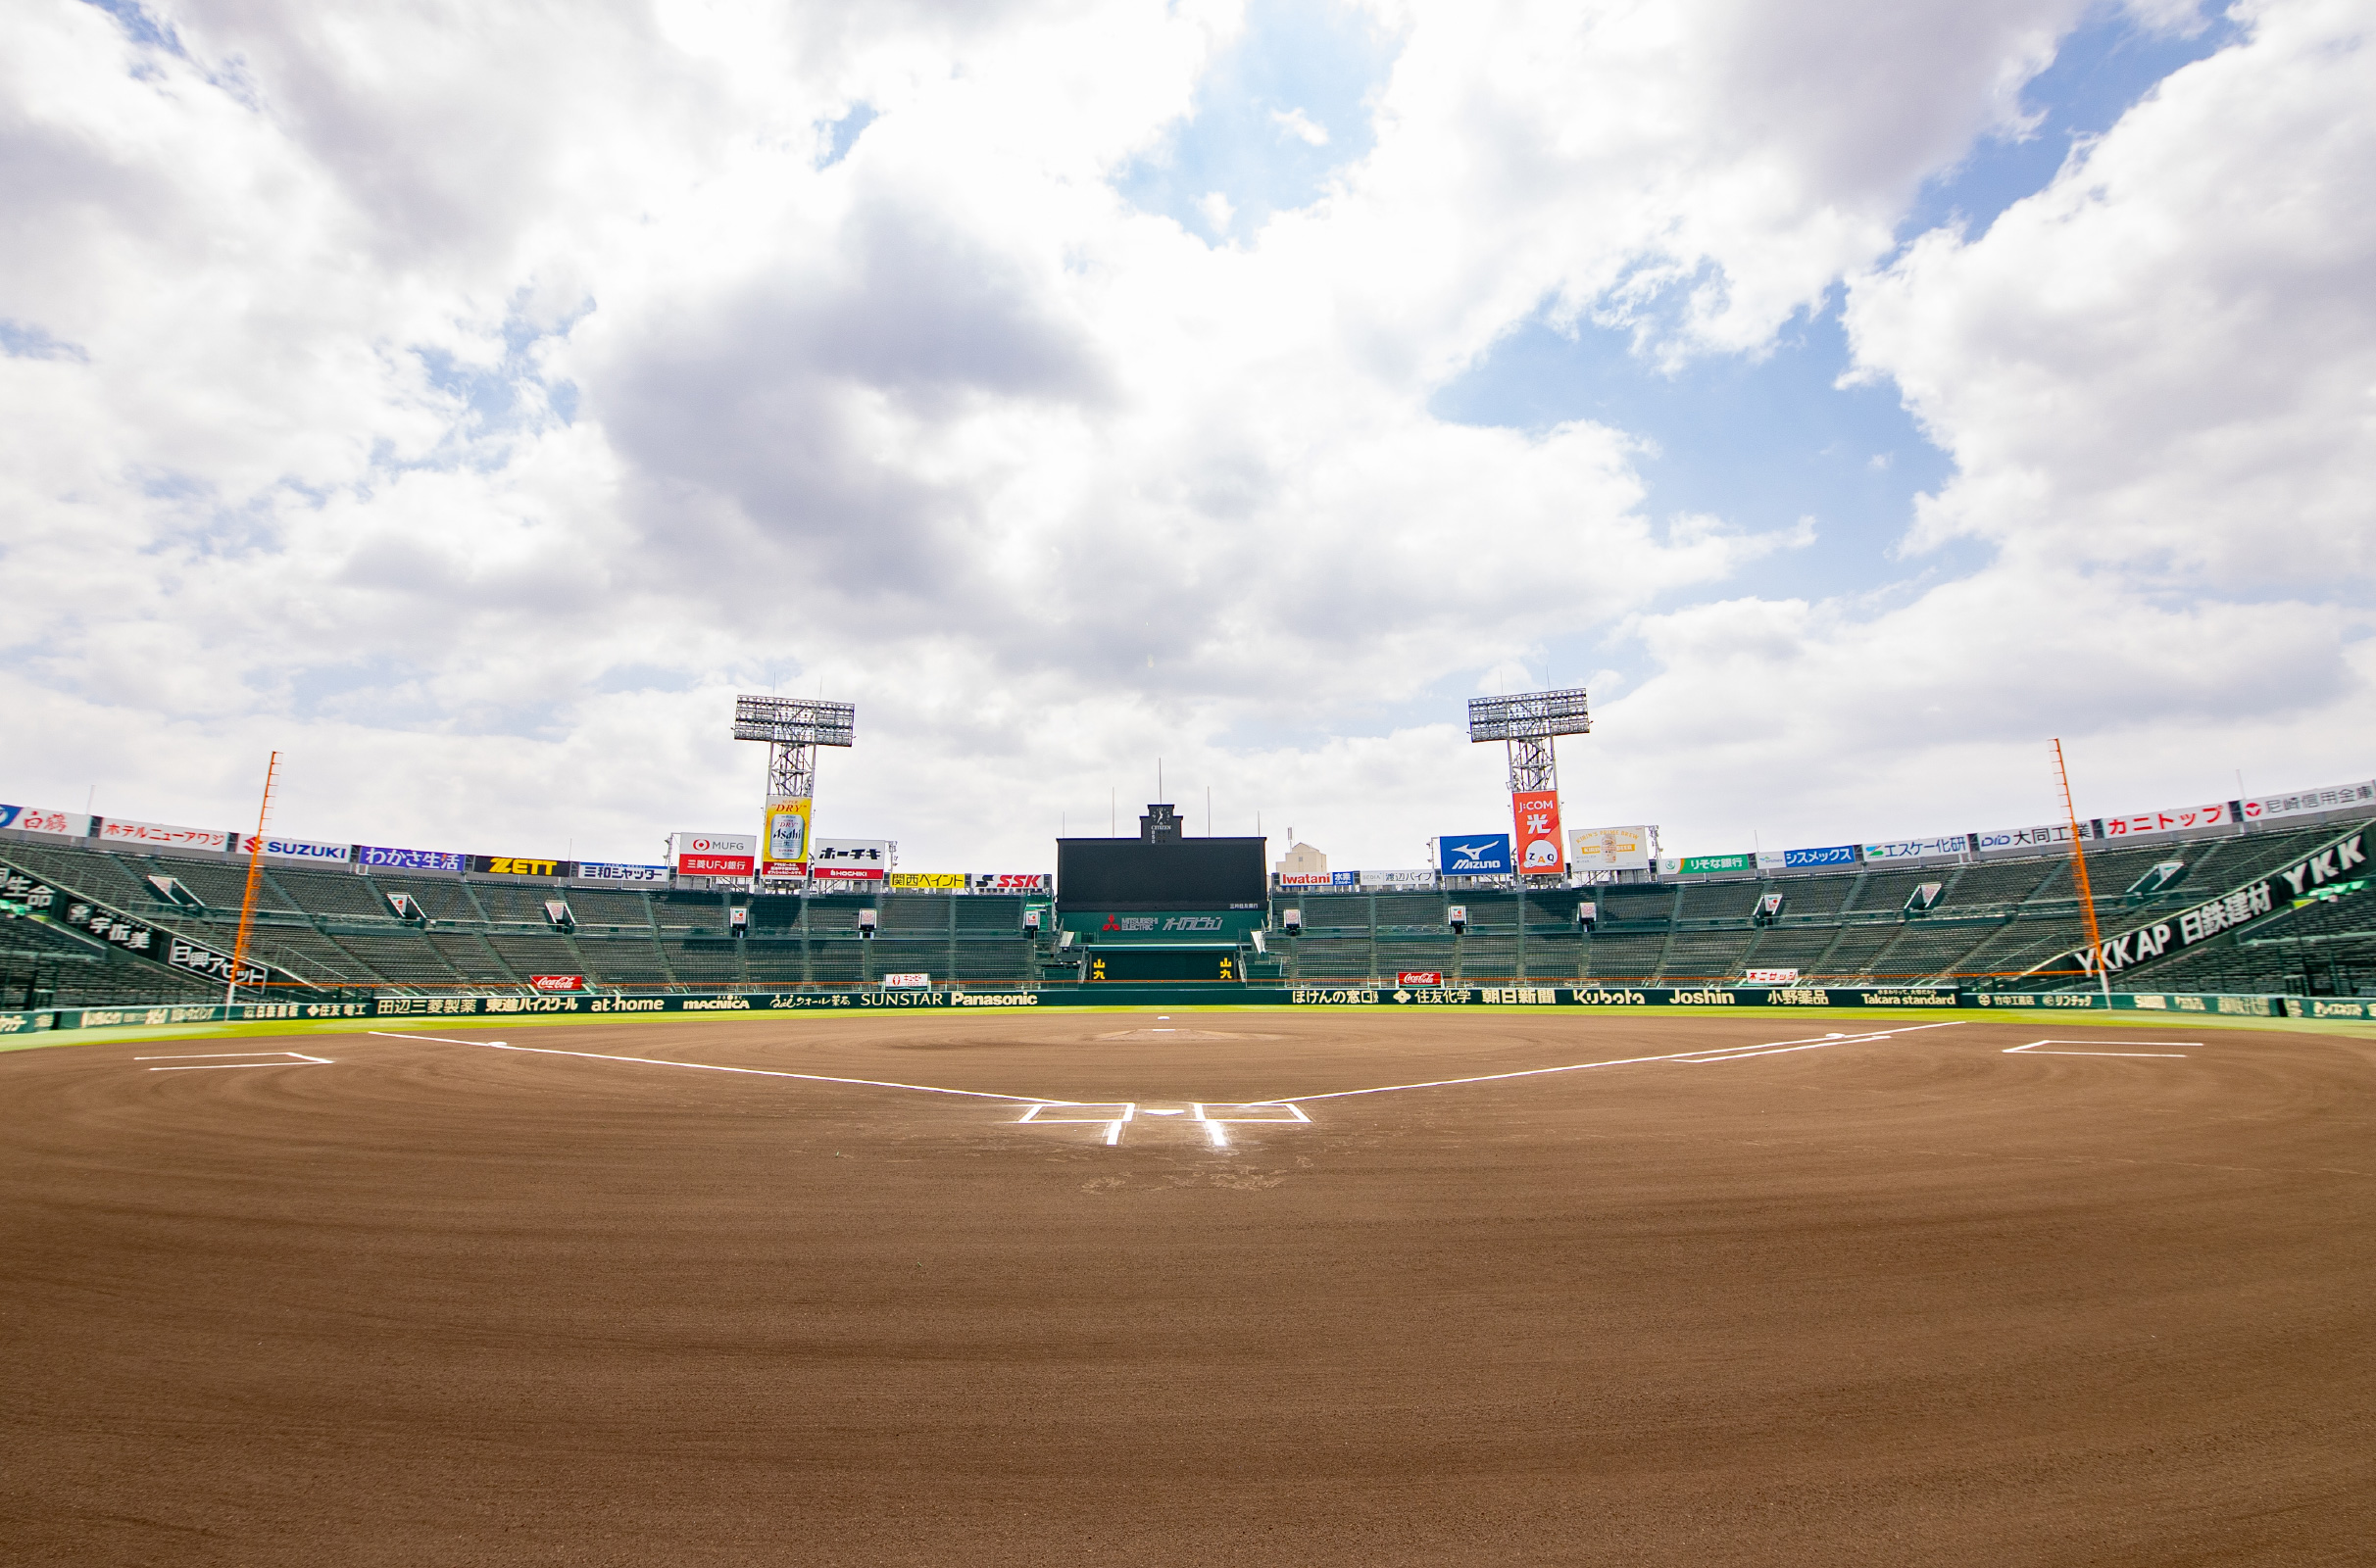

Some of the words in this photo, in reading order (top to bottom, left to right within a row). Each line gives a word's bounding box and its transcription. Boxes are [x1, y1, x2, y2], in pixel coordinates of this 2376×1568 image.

[2265, 785, 2372, 814] 尼崎信用金庫
[24, 810, 68, 832] 白鶴
[1527, 813, 1551, 834] 光
[2108, 805, 2224, 835] カニトップ
[105, 823, 224, 846] ホテルニューアワジ
[268, 841, 347, 858] SUZUKI
[712, 841, 744, 851] MUFG
[1885, 837, 1966, 858] エスケー化研
[366, 847, 460, 870] わかさ生活
[818, 847, 881, 860] ホーチキ
[1786, 848, 1852, 865] シスメックス
[488, 857, 558, 876] ZETT
[687, 858, 746, 870] 三菱UFJ銀行
[1691, 857, 1743, 870] りそな銀行
[2282, 835, 2367, 895] YKK
[584, 866, 663, 880] 三和シャッター
[892, 873, 964, 887] 関西ペイント
[1282, 873, 1331, 885] Iwatani
[1385, 871, 1433, 882] 渡辺パイプ
[996, 874, 1042, 888] SSK
[2179, 880, 2273, 946] 日鉄建材
[89, 916, 151, 949] 宇佐美
[860, 992, 943, 1006] SUNSTAR
[951, 992, 1038, 1005] Panasonic
[1292, 990, 1372, 1004] ほけんの窓口
[1414, 990, 1471, 1004] 住友化学
[1482, 990, 1556, 1004] 朝日新聞
[1573, 989, 1646, 1004] Kubota
[1669, 989, 1735, 1004] Joshin
[1767, 990, 1829, 1004] 小野薬品
[1860, 993, 1902, 1004] Takara
[1902, 993, 1956, 1005] standard
[319, 1004, 367, 1016] 住友電工
[485, 997, 578, 1012] 東進ハイスクール
